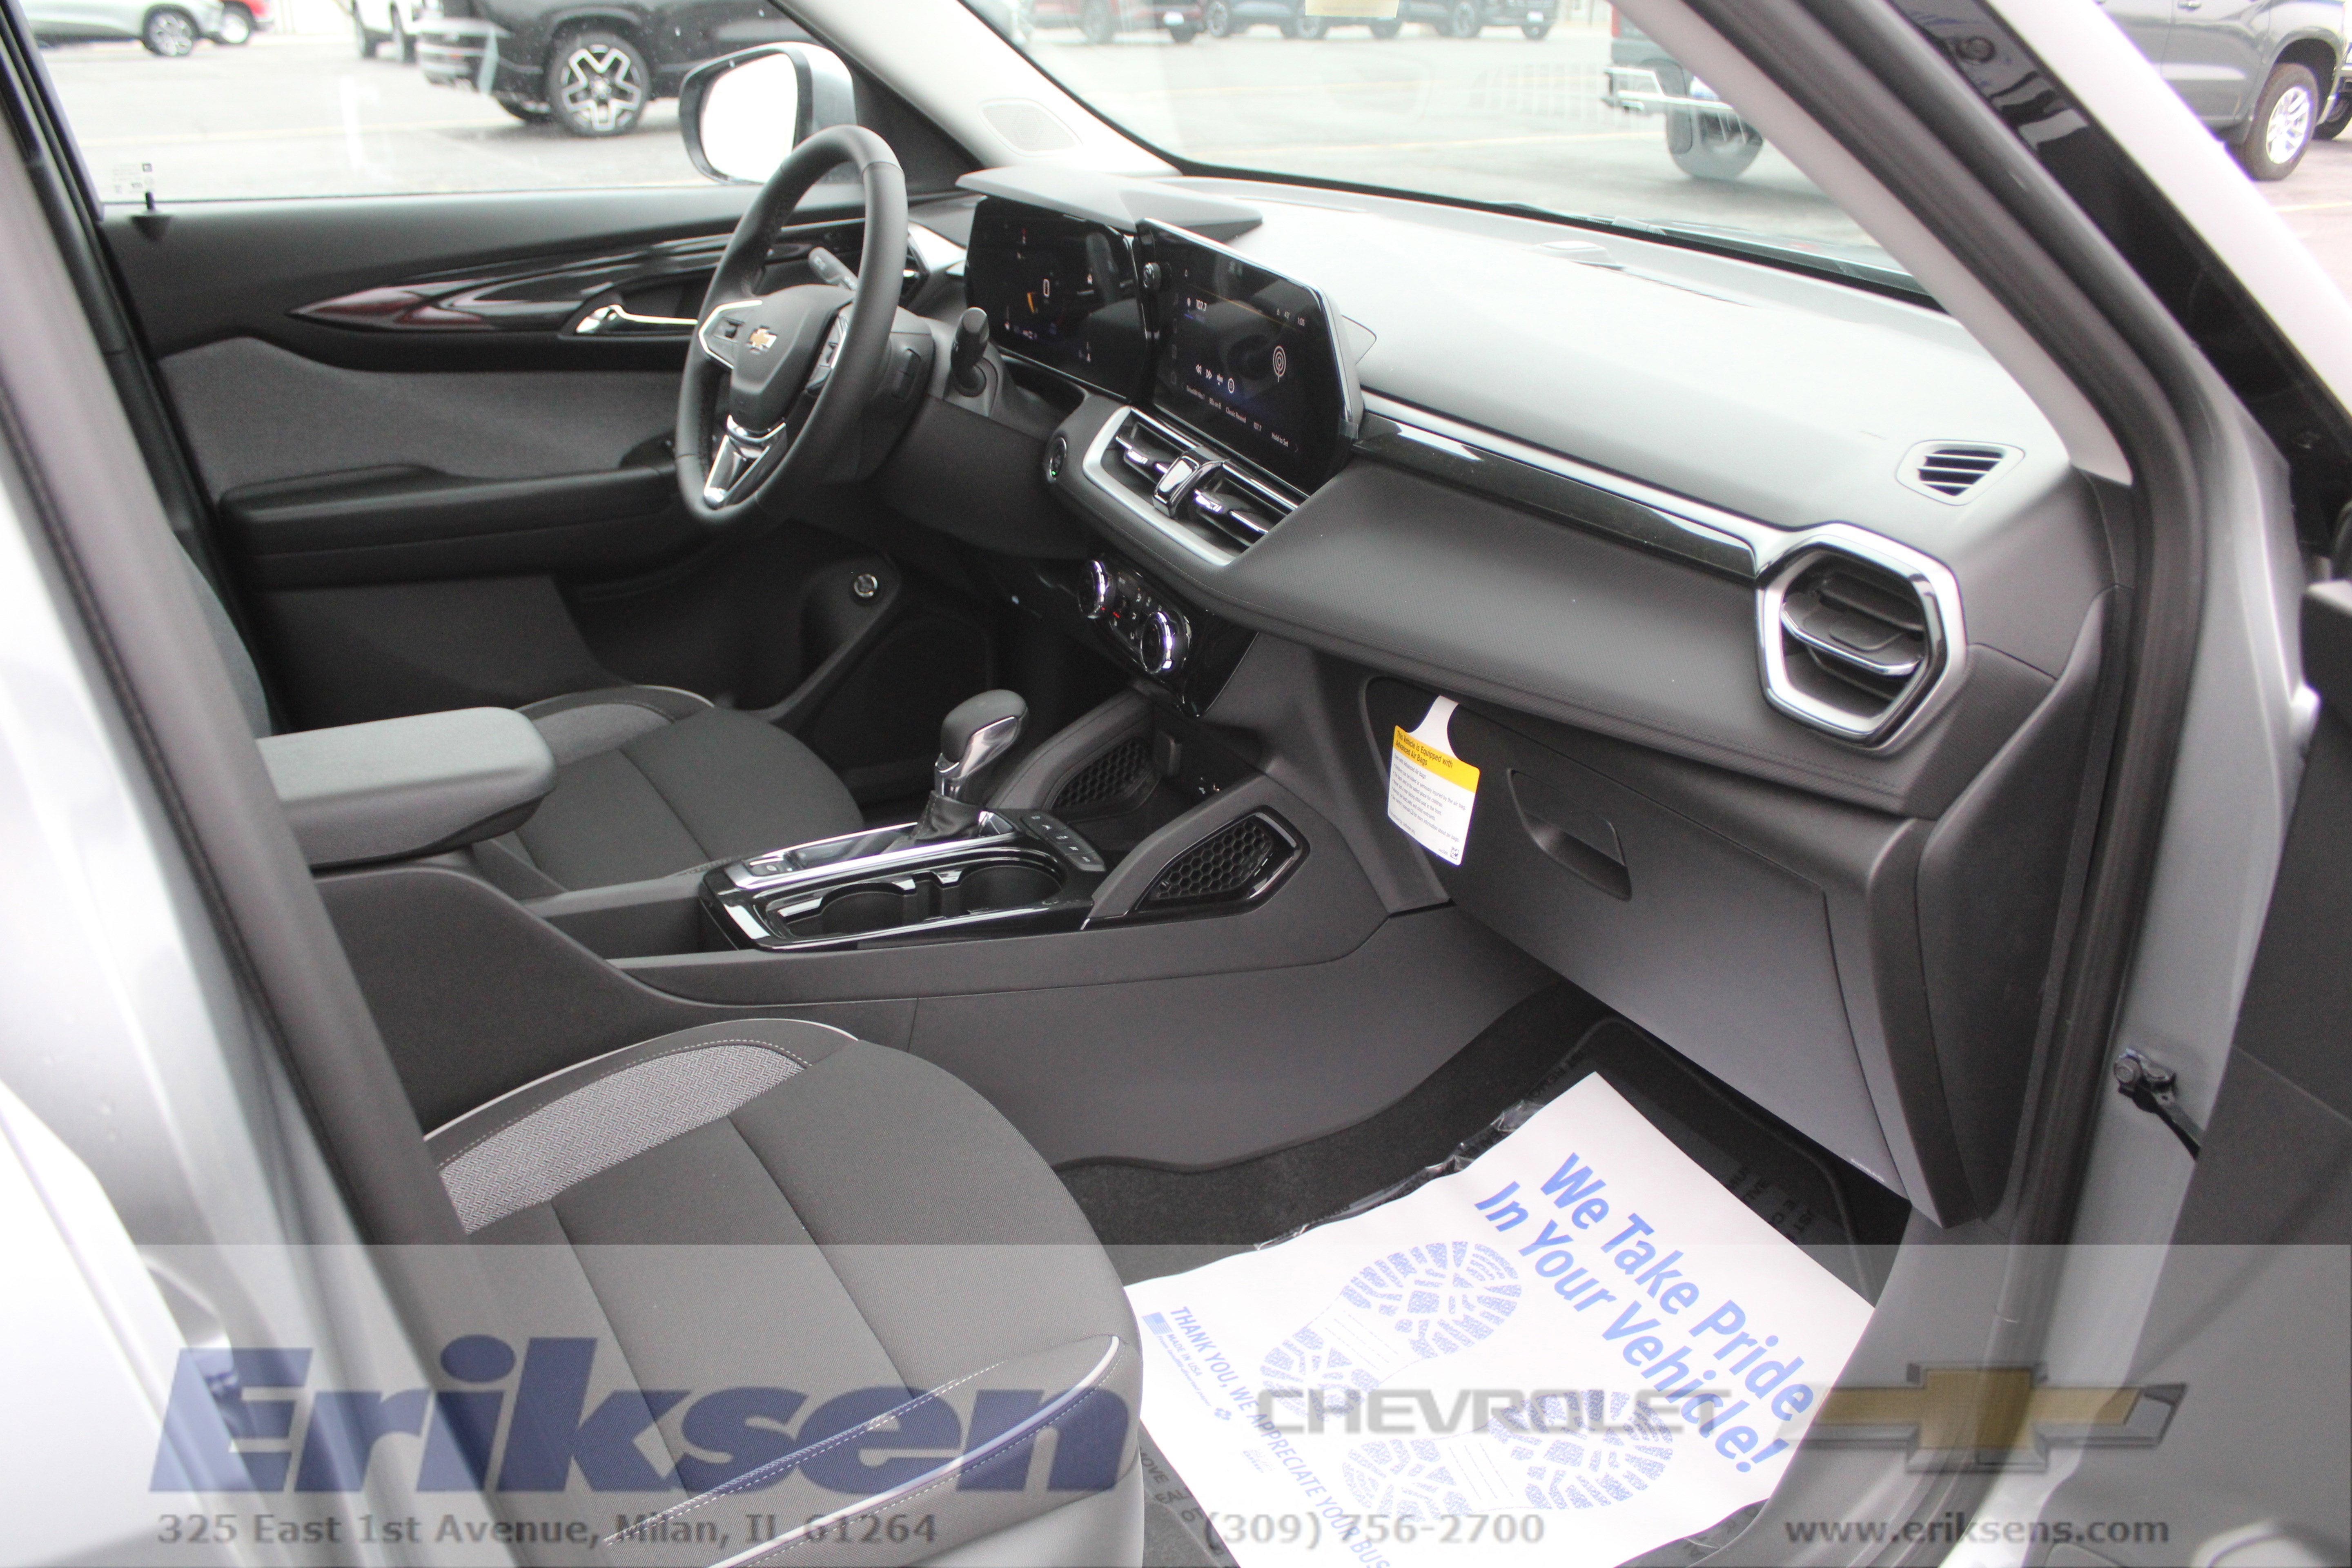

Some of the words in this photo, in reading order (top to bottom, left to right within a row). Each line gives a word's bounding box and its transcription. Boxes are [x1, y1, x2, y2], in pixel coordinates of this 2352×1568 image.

[1196, 299, 1207, 312] 107.7
[1396, 739, 1410, 756] Advanced
[1417, 753, 1428, 768] Bags
[1403, 735, 1416, 750] Vehicle
[1416, 743, 1420, 752] is
[1420, 745, 1441, 764] Equipped
[1441, 756, 1453, 769] with
[1540, 1152, 1609, 1229] We
[1600, 1212, 1699, 1315] Take
[1688, 1299, 1813, 1421] Pride
[1157, 1335, 1169, 1349] From
[1474, 1180, 1528, 1232] In
[1518, 1219, 1617, 1312] Your
[1602, 1300, 1789, 1472] Vehicle!
[1166, 1334, 1186, 1352] MADE
[1188, 1362, 1203, 1376] USA
[1170, 1306, 1217, 1352] THANK
[1205, 1352, 1239, 1388] YOU,
[1229, 1386, 1259, 1411] WE
[1246, 1413, 1327, 1497] APPRECIATE
[1315, 1496, 1361, 1541] YOUR
